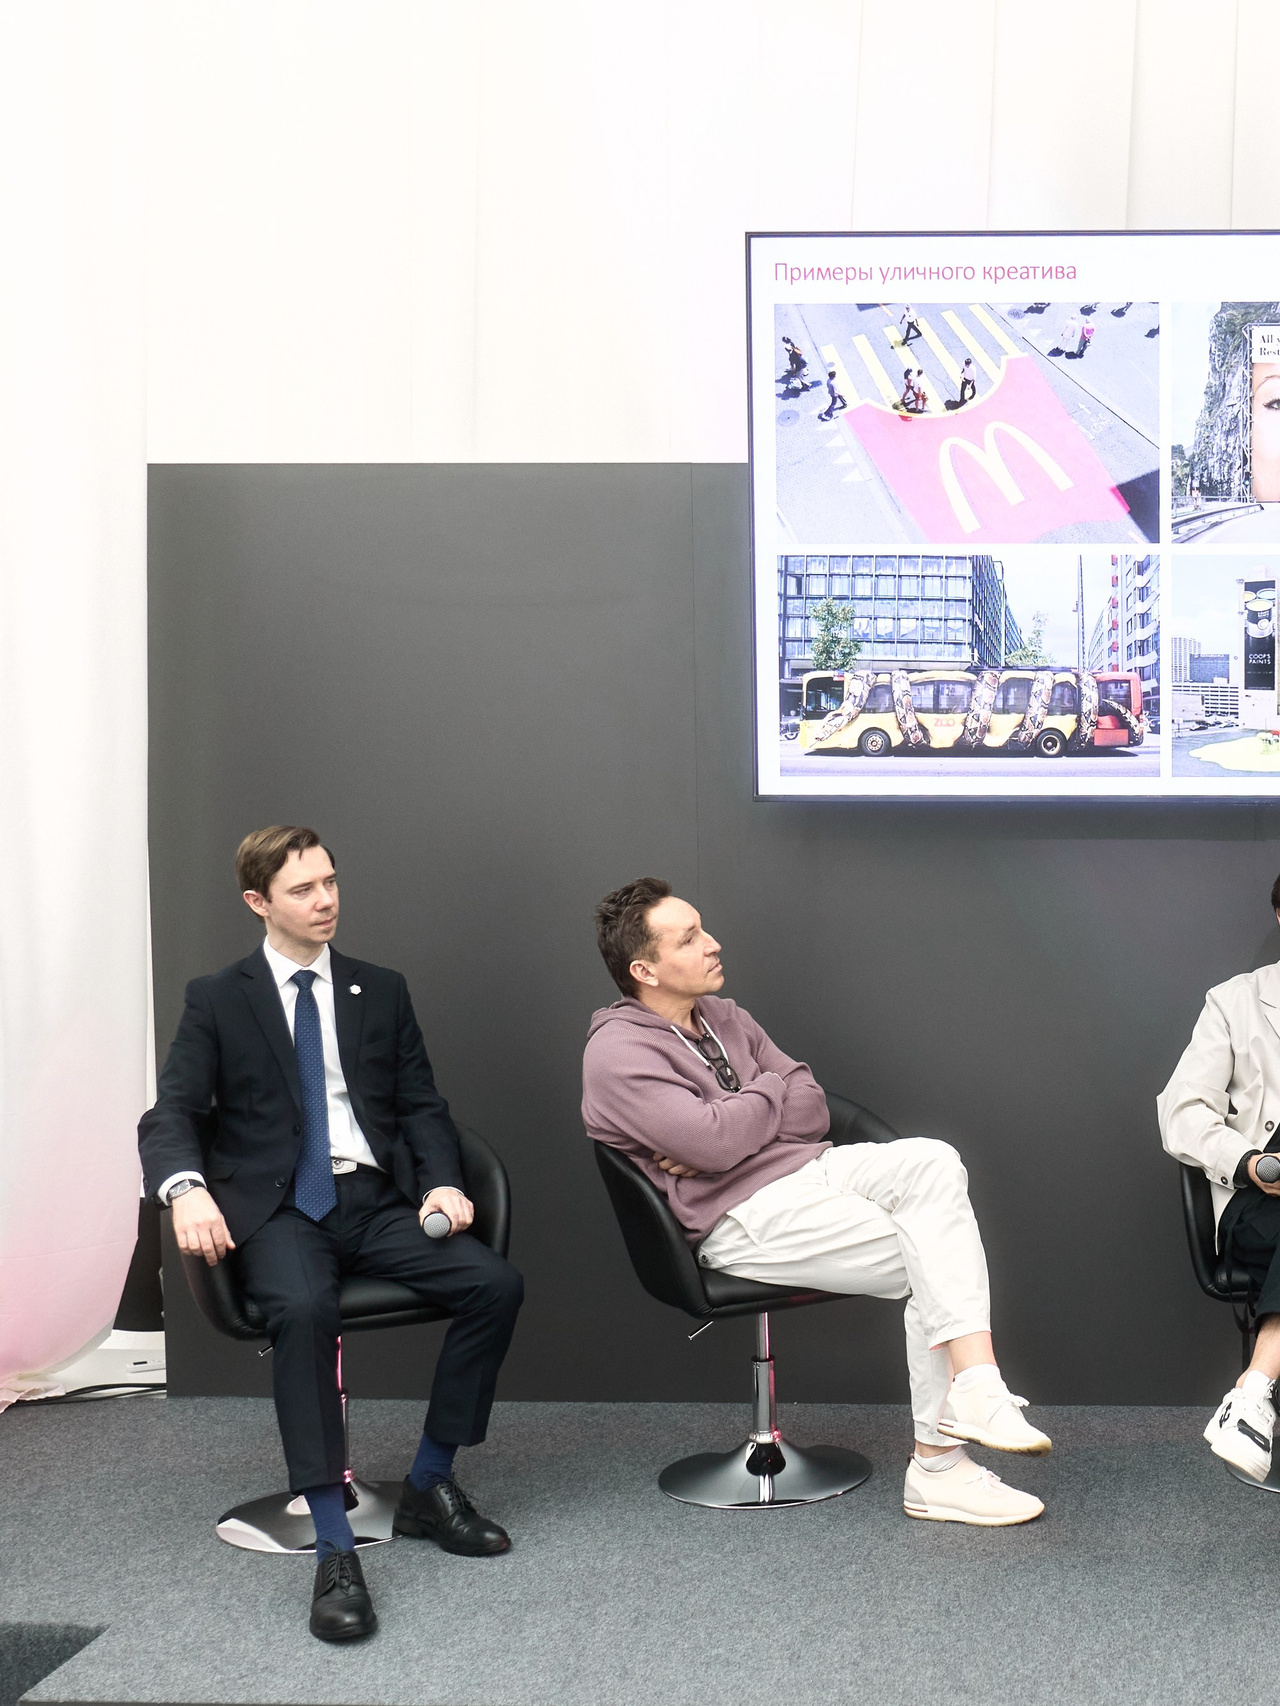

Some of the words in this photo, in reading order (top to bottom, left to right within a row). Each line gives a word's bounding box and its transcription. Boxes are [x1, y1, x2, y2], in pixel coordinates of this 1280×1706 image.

[774, 262, 873, 285] Примеры
[879, 265, 976, 285] уличного
[982, 265, 1078, 284] креатива
[1260, 334, 1273, 343] All
[1260, 347, 1280, 356] Rest
[933, 717, 956, 727] ZOO
